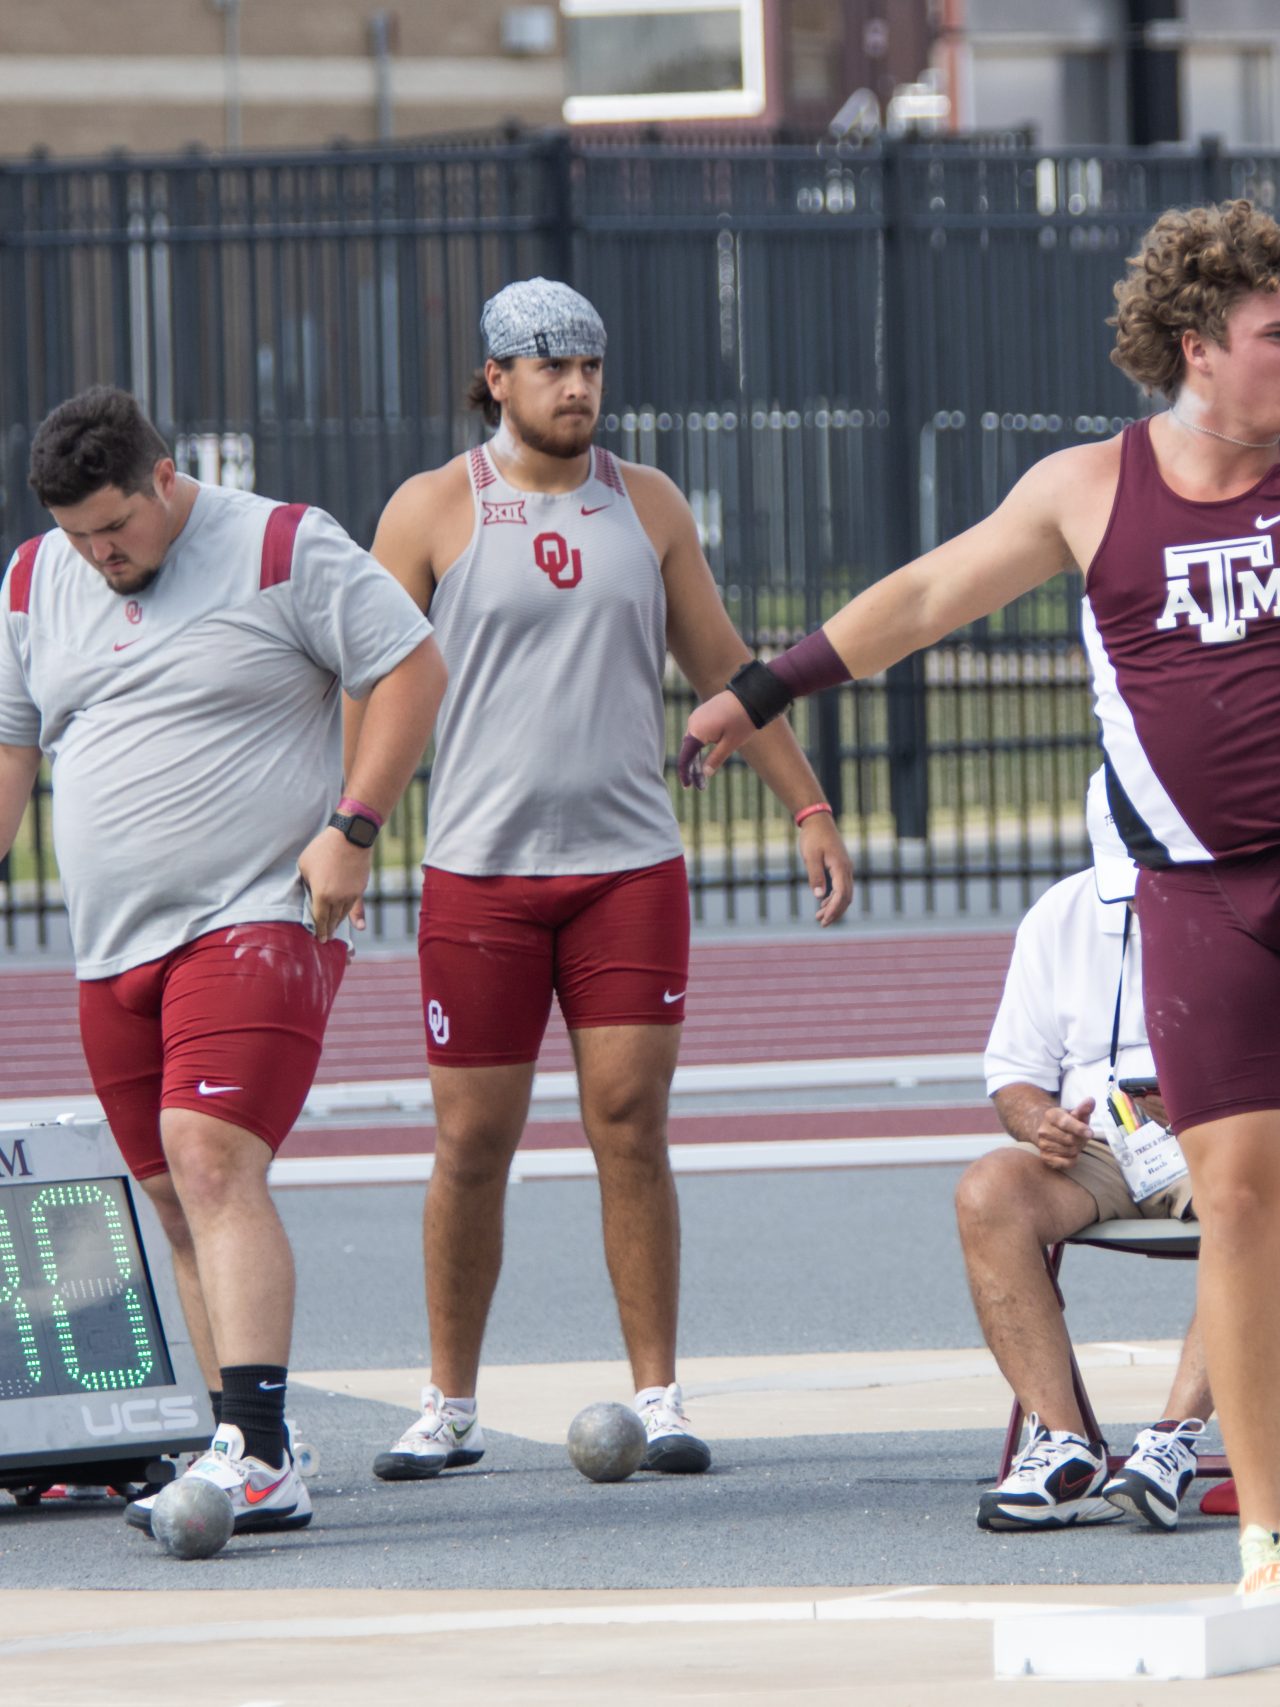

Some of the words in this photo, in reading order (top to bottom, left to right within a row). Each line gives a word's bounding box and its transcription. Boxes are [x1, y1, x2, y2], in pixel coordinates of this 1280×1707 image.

[533, 531, 583, 589] OU
[428, 999, 450, 1045] OU
[81, 1395, 199, 1436] UCS
